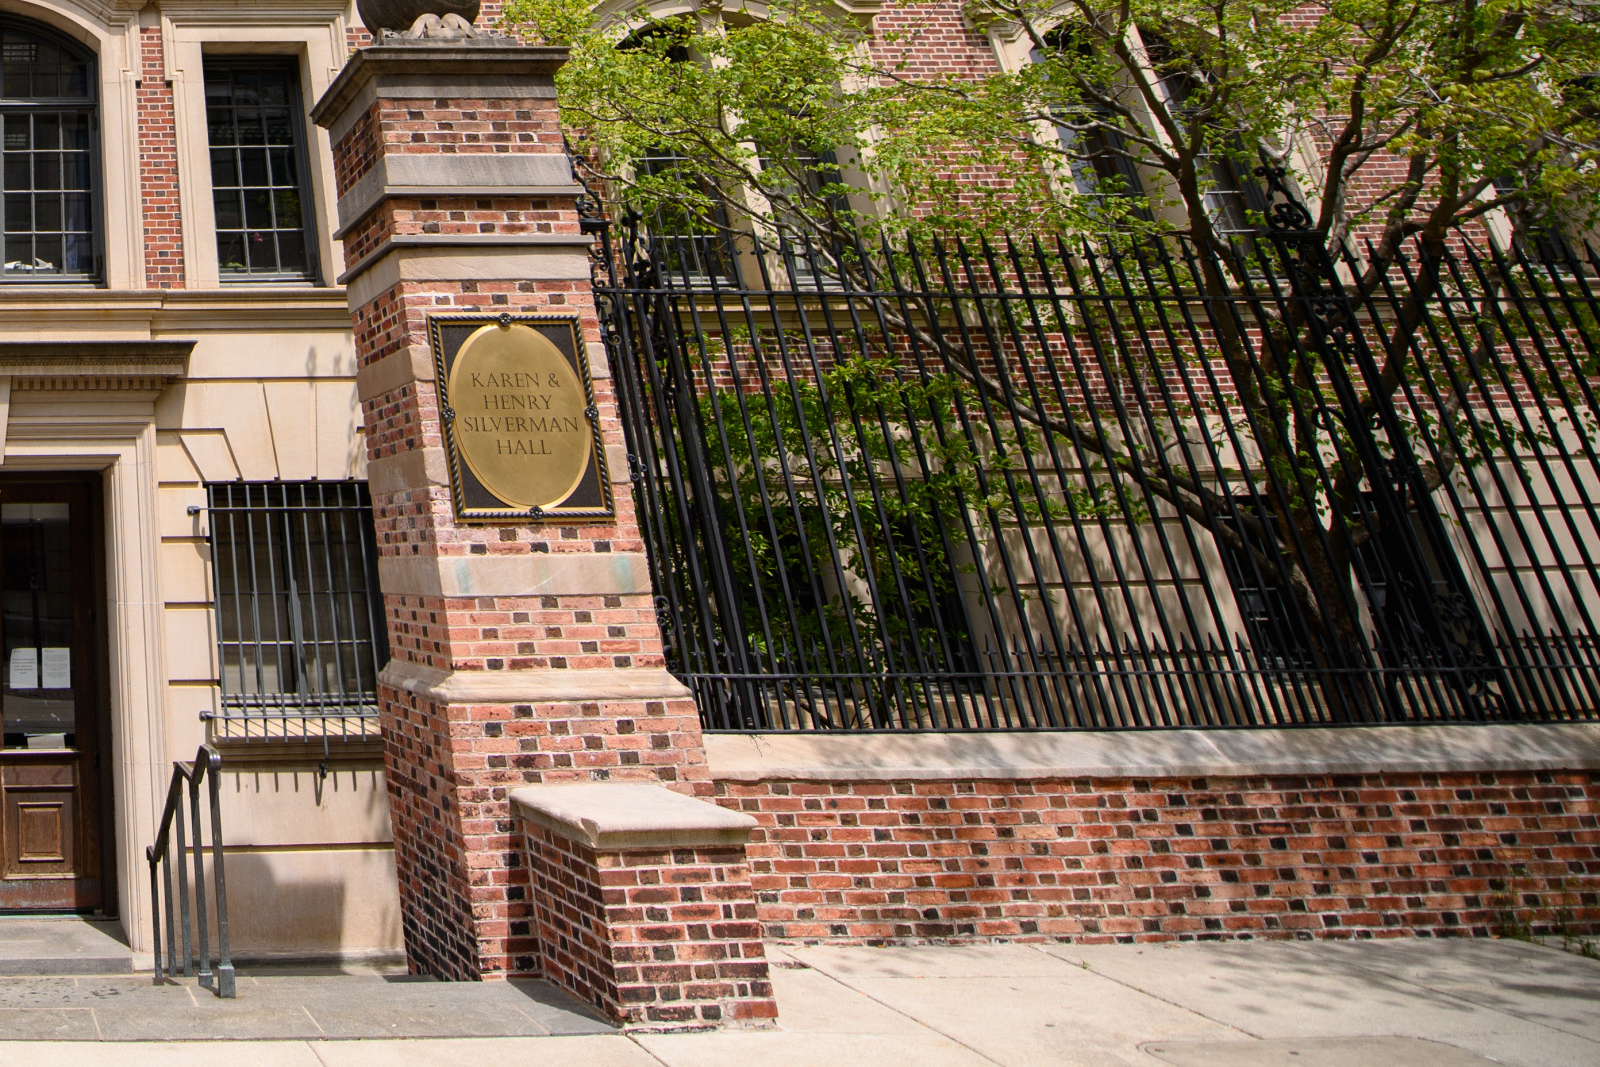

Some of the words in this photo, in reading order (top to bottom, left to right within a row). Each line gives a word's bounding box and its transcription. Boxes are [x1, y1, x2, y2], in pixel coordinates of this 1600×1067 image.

[470, 372, 540, 388] KAREN
[547, 372, 562, 388] &
[482, 394, 552, 410] HENRY
[463, 416, 579, 433] SILVERMAN
[495, 439, 552, 455] HALL
